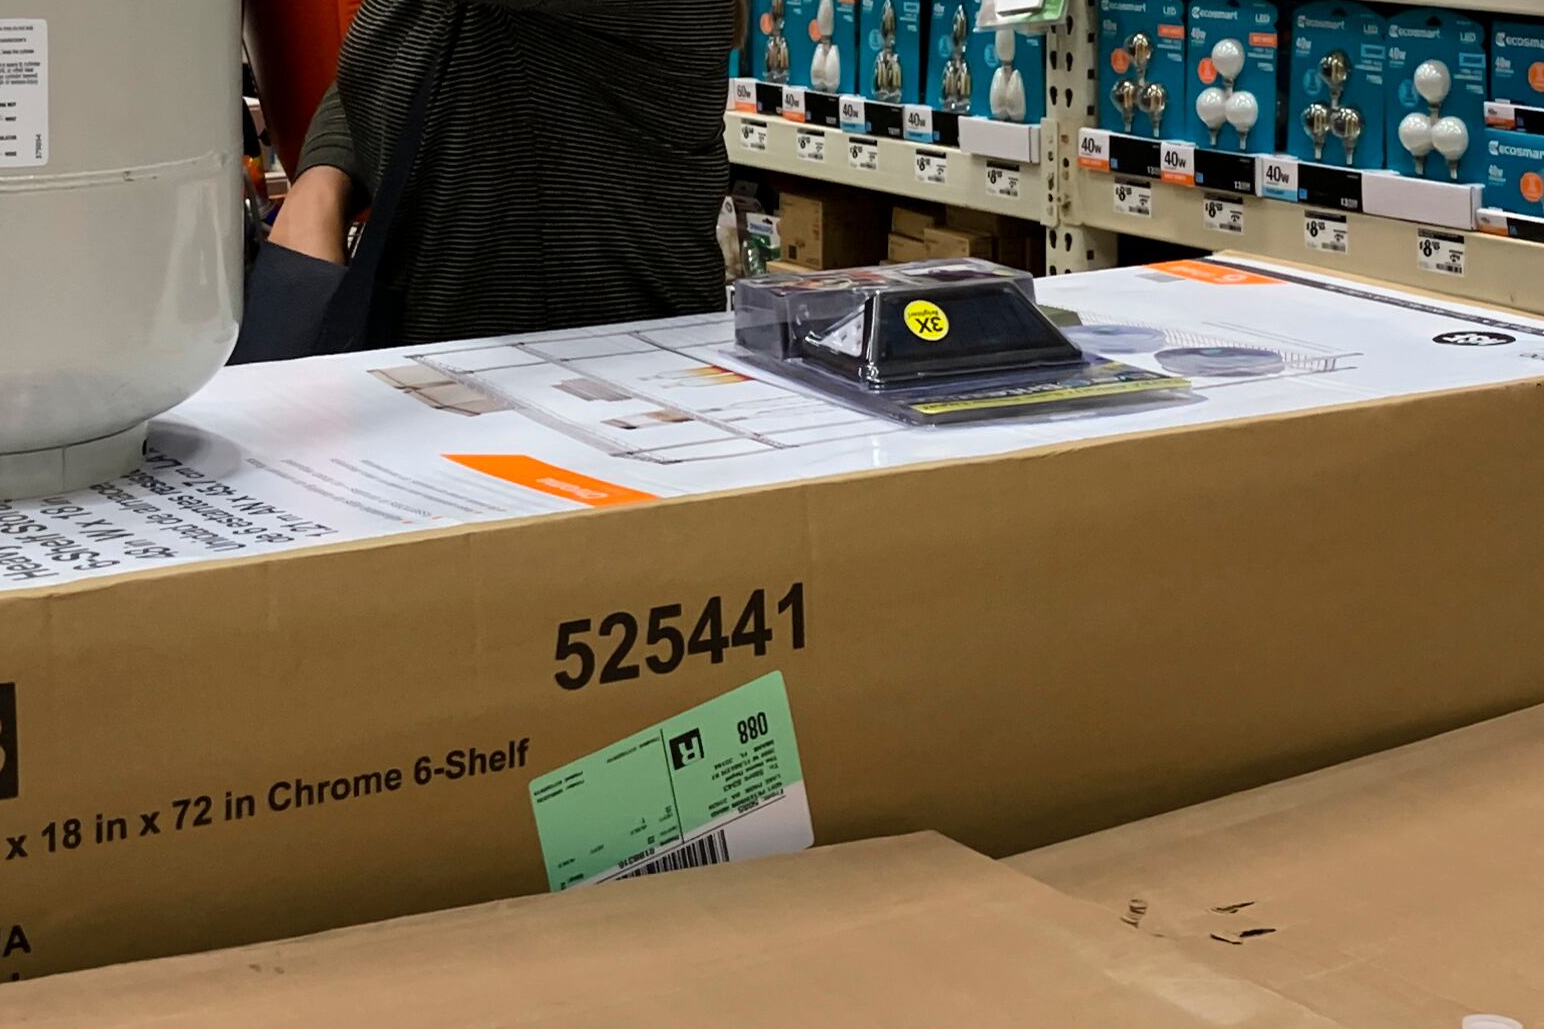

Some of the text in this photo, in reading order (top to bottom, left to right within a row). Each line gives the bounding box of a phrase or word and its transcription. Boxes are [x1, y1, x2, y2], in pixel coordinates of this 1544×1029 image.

[1505, 35, 1544, 49] ecosma
[1498, 144, 1544, 160] ecosmar
[915, 316, 943, 334] 3X
[168, 495, 254, 527] estantes
[170, 523, 247, 553] Unidad
[232, 525, 257, 535] 6
[255, 532, 295, 544] de
[555, 582, 805, 690] 525441
[737, 711, 768, 745] 088
[6, 834, 28, 860] x
[41, 818, 82, 853] 18
[95, 814, 128, 844] in
[140, 811, 161, 836] x
[172, 795, 213, 831] 72
[225, 789, 256, 820] in
[267, 763, 403, 813] Chrome
[413, 738, 532, 787] 6-Shelf
